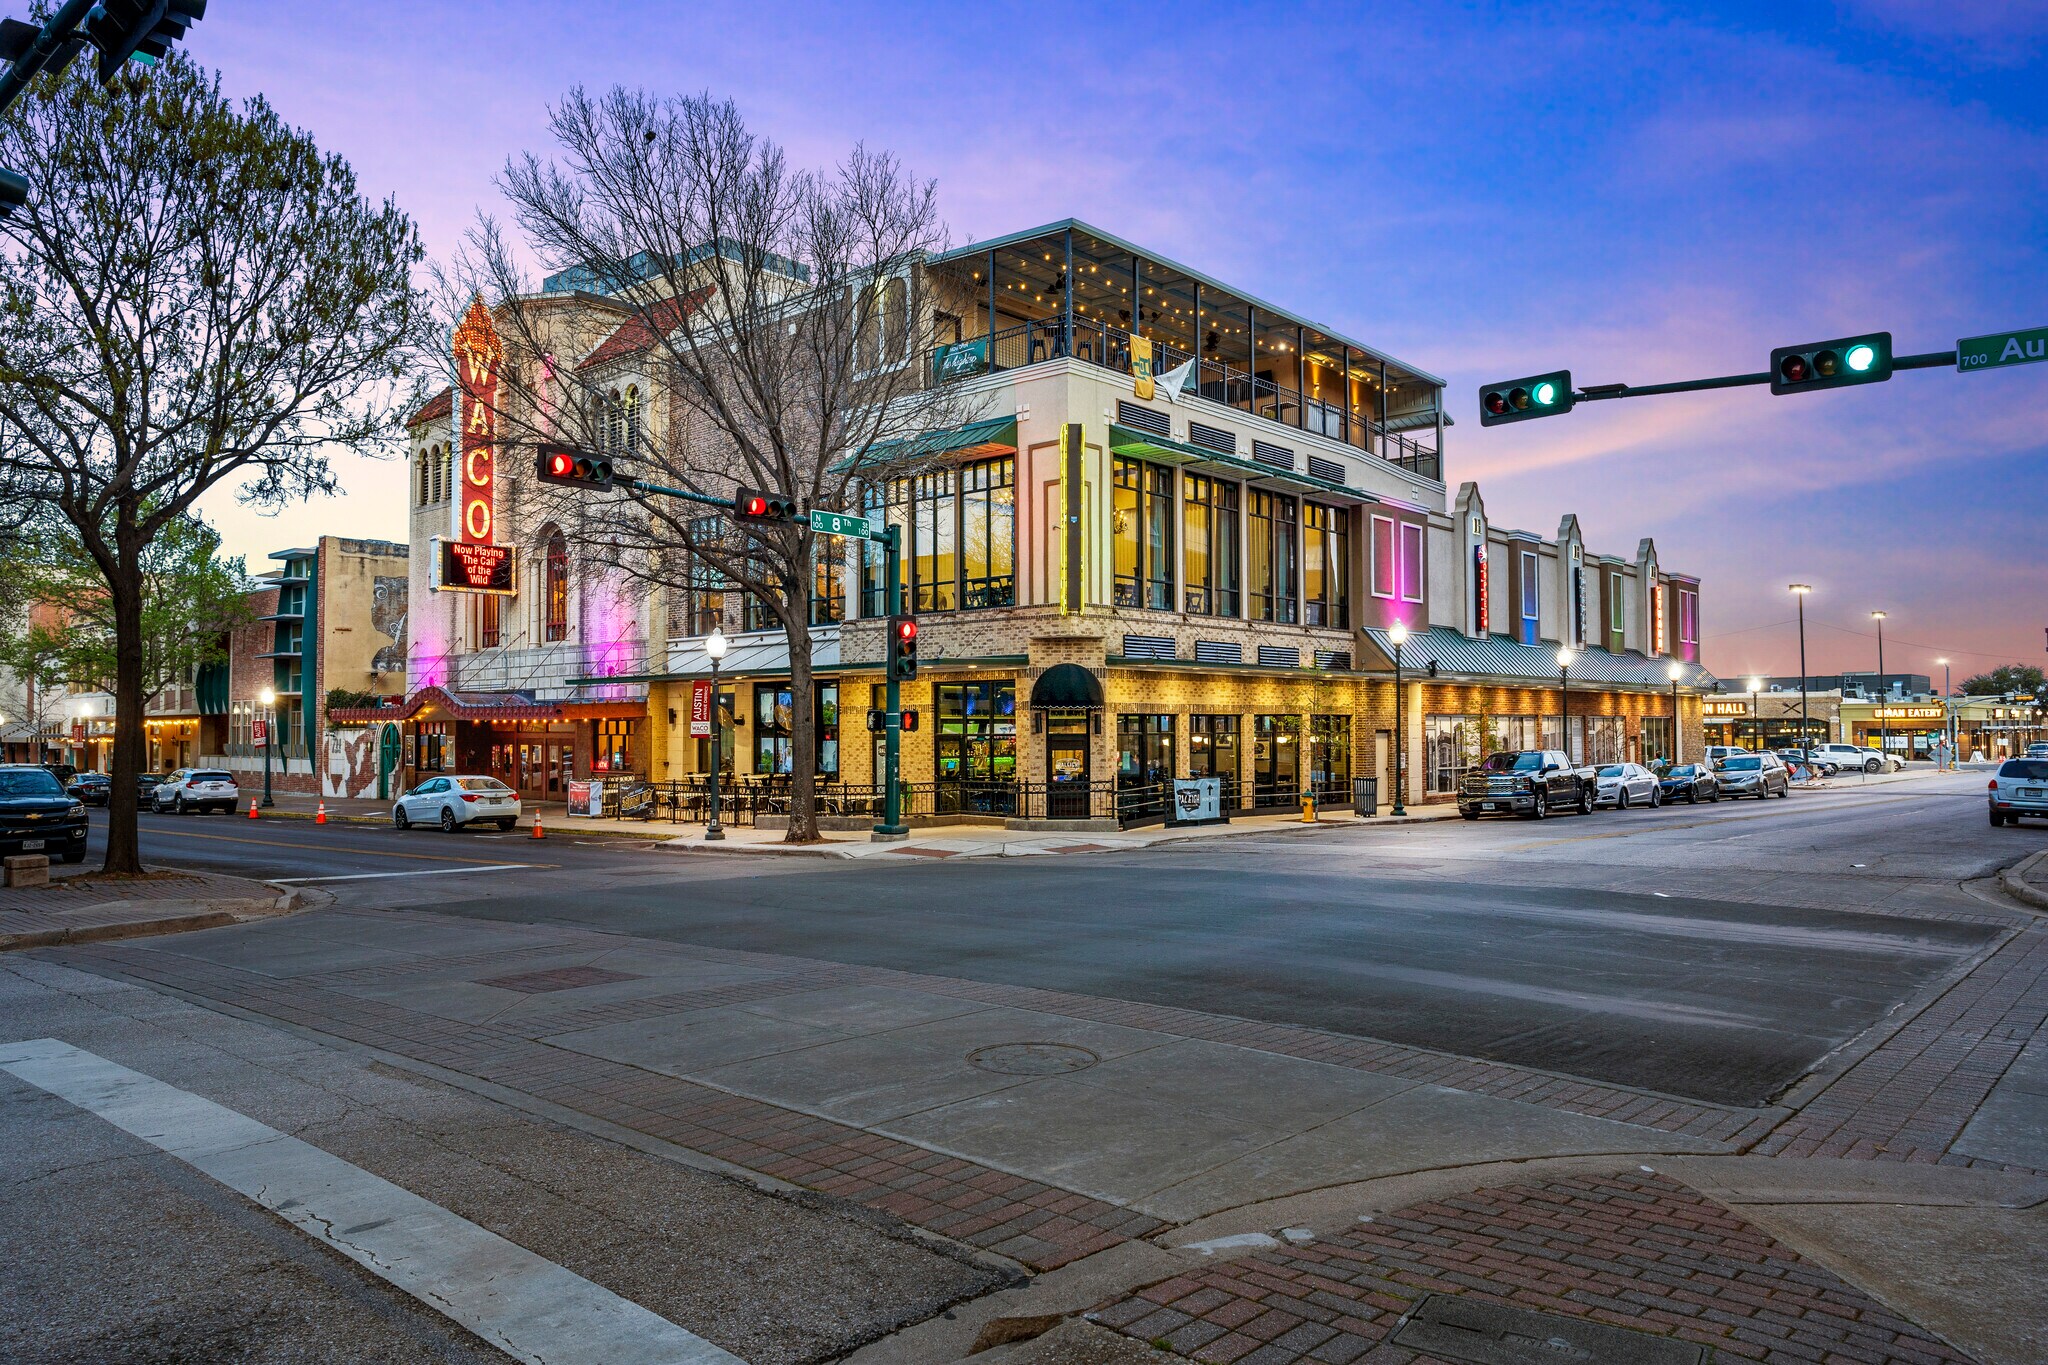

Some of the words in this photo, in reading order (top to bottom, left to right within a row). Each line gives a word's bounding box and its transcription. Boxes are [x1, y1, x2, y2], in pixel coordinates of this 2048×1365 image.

[1962, 353, 1988, 367] 700
[1999, 337, 2045, 362] Au
[461, 340, 494, 539] WACO
[813, 521, 823, 529] 100
[858, 527, 869, 536] 100
[832, 517, 841, 531] 8
[843, 519, 851, 527] Th
[454, 544, 472, 554] Now
[474, 546, 504, 559] Playing
[463, 555, 478, 565] The
[480, 556, 495, 566] Call
[467, 566, 476, 574] of
[477, 566, 491, 576] the
[470, 575, 488, 584] Wild
[693, 688, 703, 720] AUSTIN
[1717, 703, 1745, 714] HALL
[1907, 708, 1942, 717] EATERY
